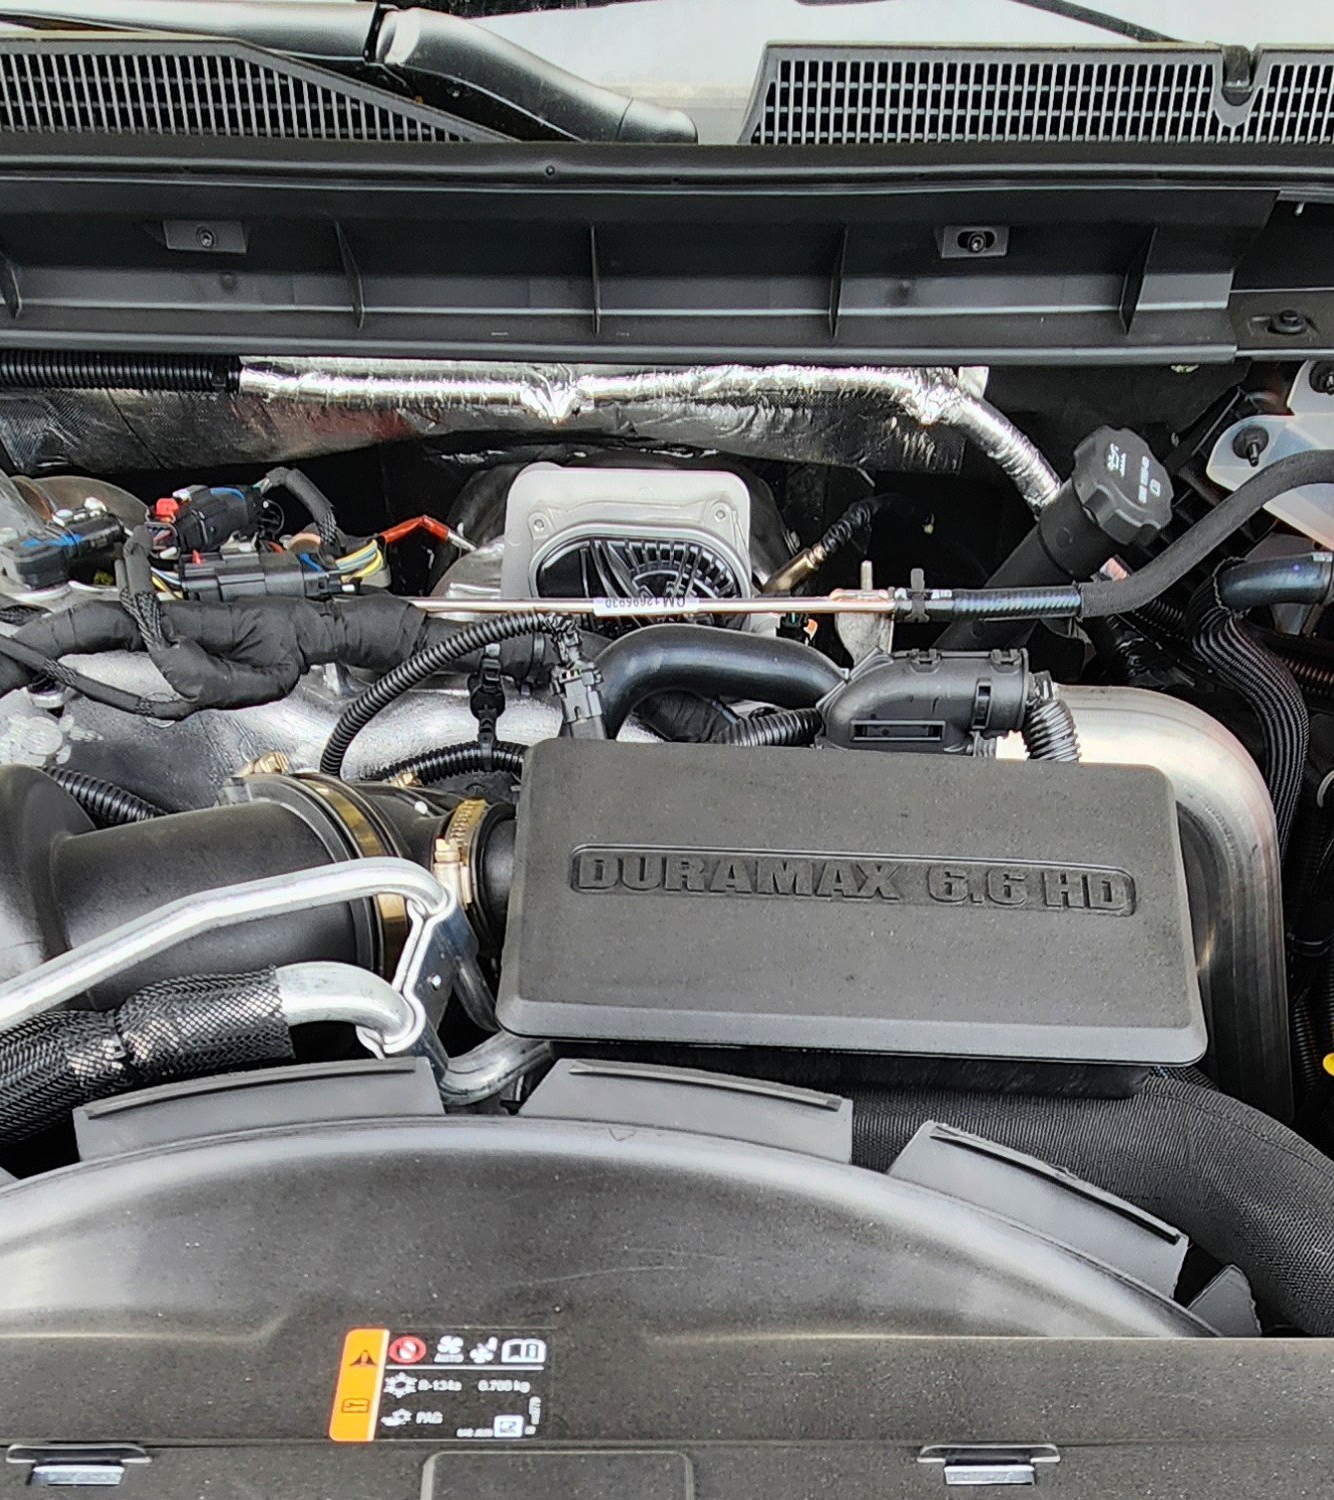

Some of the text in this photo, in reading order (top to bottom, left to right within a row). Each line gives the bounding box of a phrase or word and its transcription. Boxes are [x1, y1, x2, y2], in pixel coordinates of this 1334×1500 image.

[578, 855, 1133, 911] DURAMAX 6.6 HD
